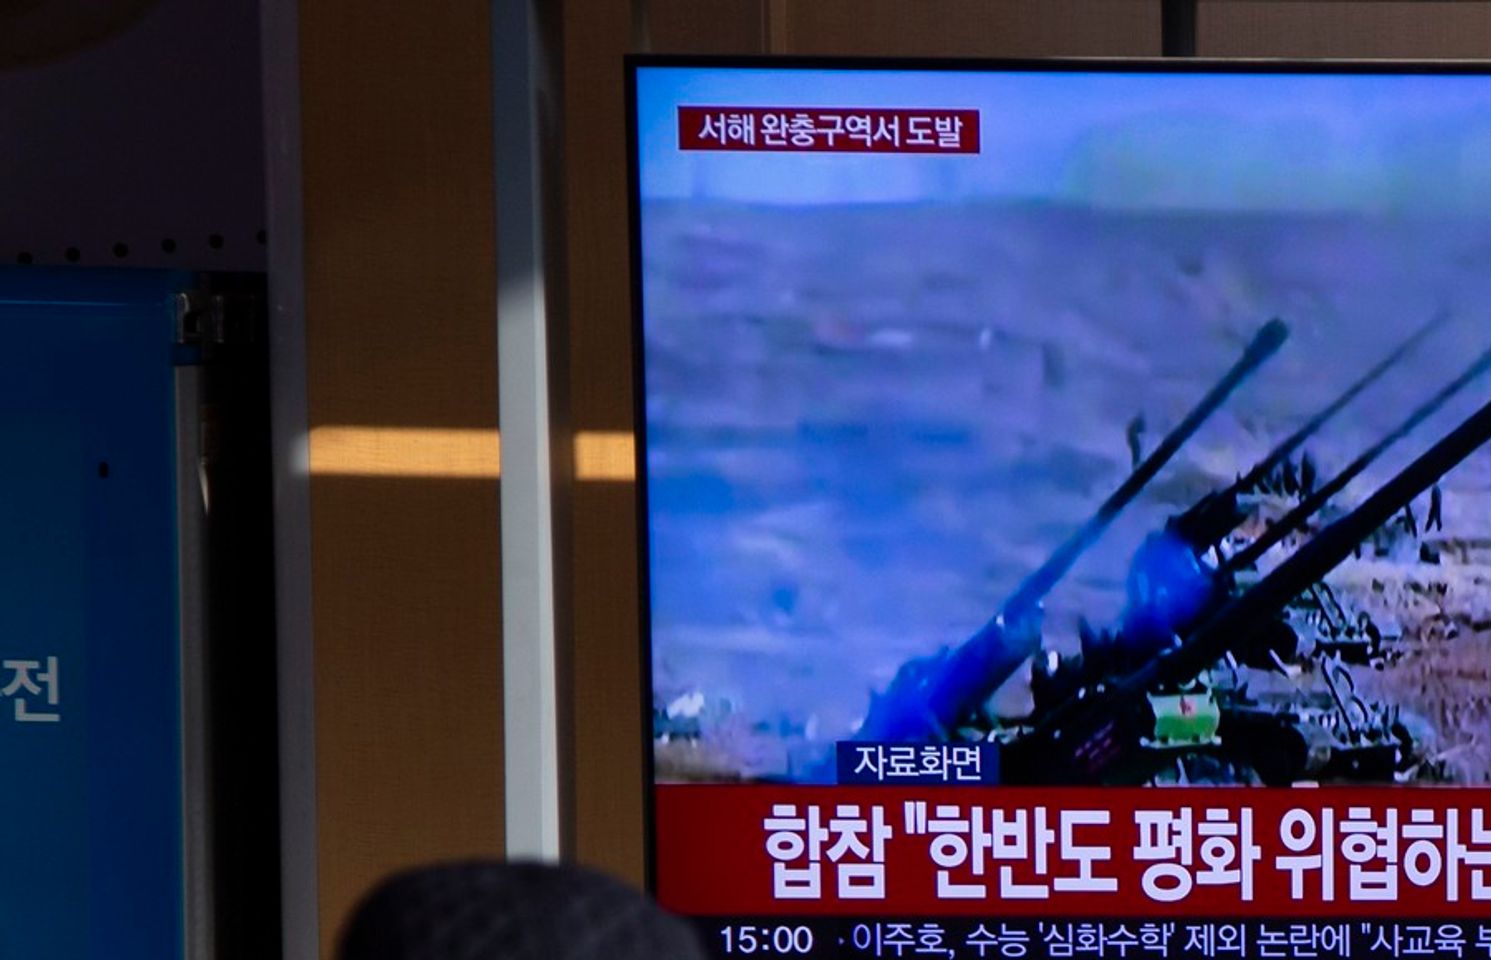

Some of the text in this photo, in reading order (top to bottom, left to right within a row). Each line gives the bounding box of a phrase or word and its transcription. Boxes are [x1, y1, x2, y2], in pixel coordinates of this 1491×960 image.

[699, 112, 963, 149] 서해 완충구역서 도발
[0, 656, 61, 722] 전
[853, 745, 982, 781] 자료화면
[763, 804, 893, 900] 합참
[904, 801, 1119, 900] "한반도
[1133, 806, 1262, 902] 평화
[721, 926, 814, 954] 15:00
[852, 922, 955, 959] 이주호,
[965, 924, 1030, 957] 수능
[1038, 922, 1175, 958] '심화수학'
[1184, 922, 1247, 958] 제외
[1257, 924, 1351, 958] 논란에
[1361, 922, 1467, 959] "사교육
